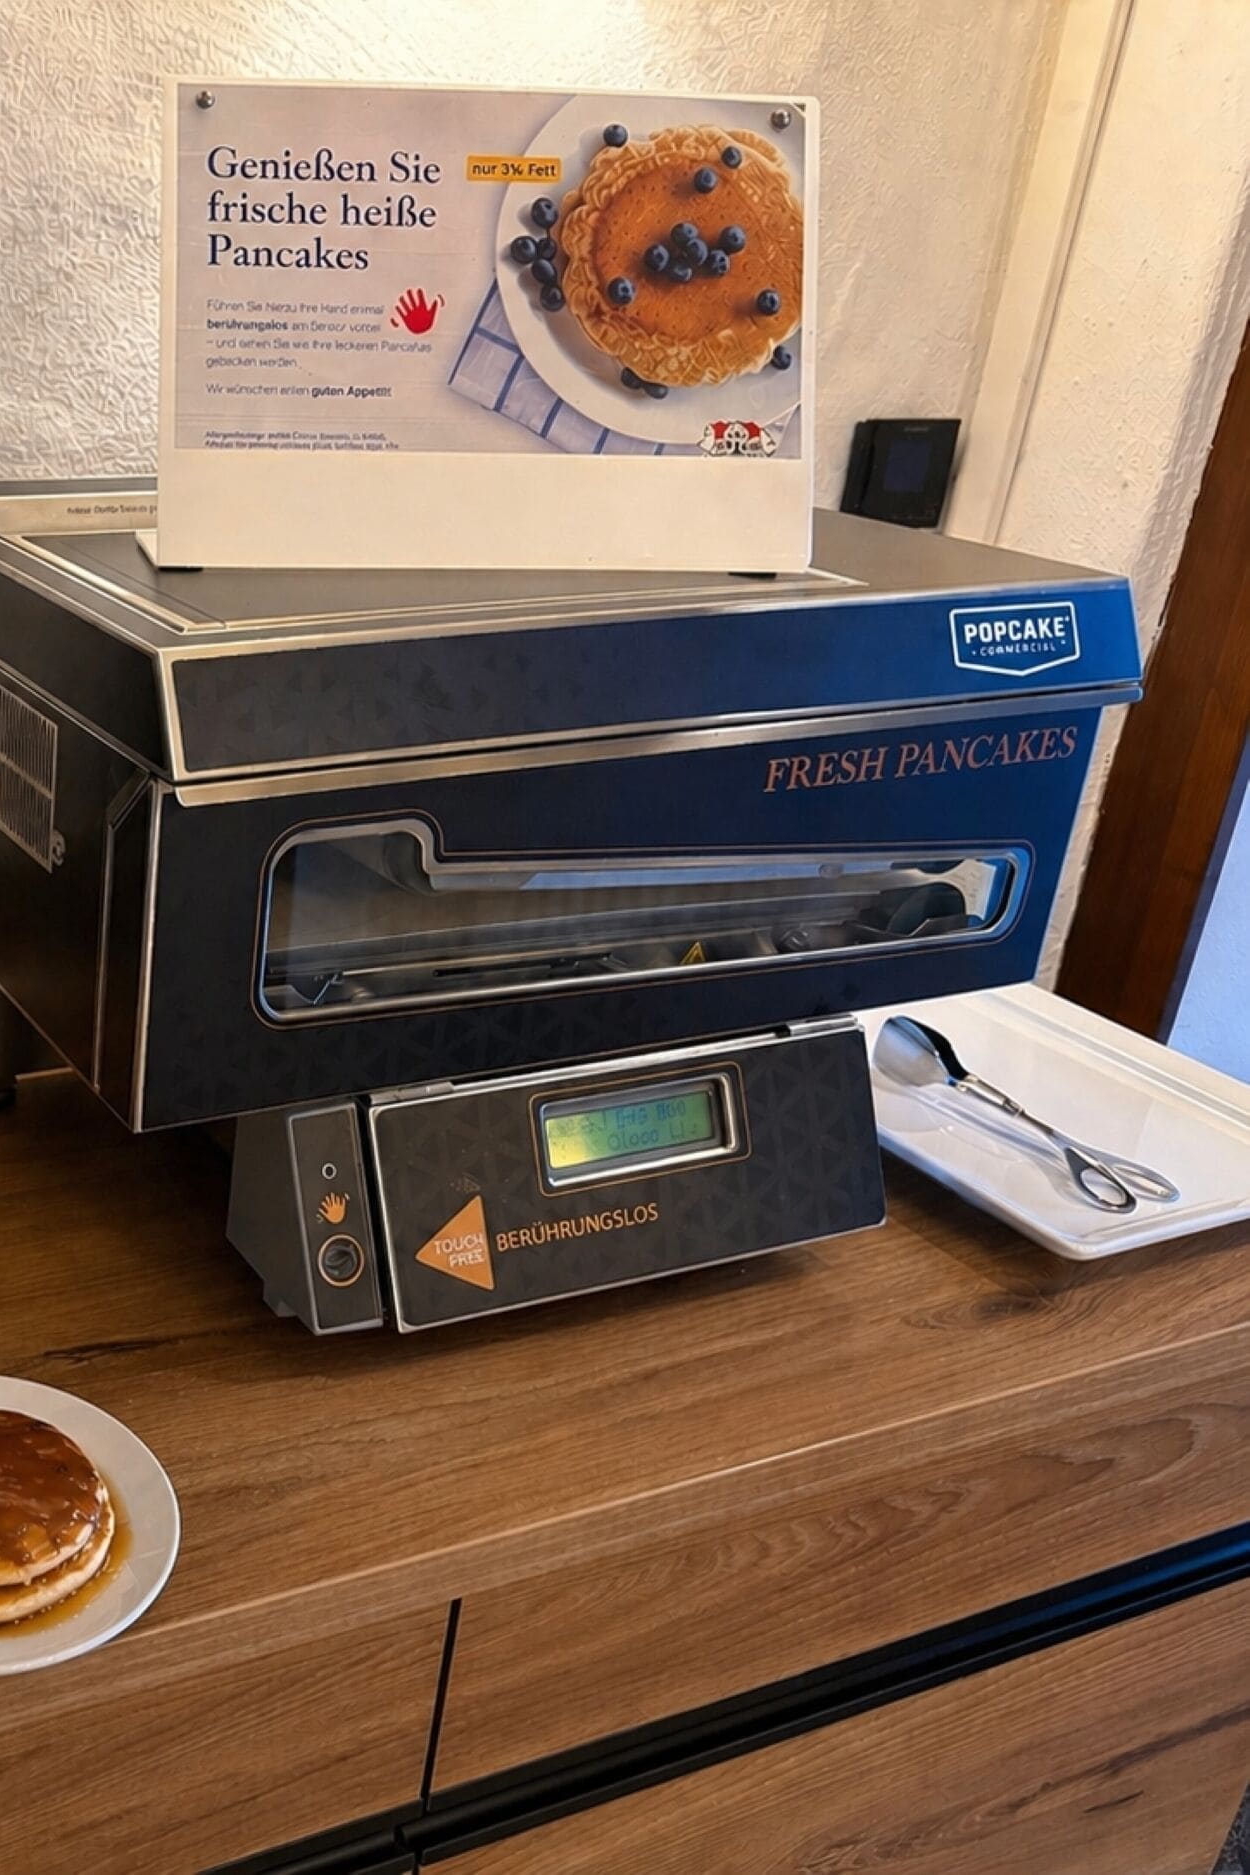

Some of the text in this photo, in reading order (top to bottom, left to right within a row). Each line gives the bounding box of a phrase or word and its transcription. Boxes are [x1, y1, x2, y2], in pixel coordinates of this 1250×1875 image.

[208, 146, 441, 183] Genießen Sie
[472, 163, 557, 177] nur 3% Fett
[207, 190, 438, 227] frische heiße
[207, 234, 369, 270] Pancakes
[963, 615, 1066, 644] POPCAKE
[763, 725, 1079, 793] FRESH PANCAKES
[434, 1232, 484, 1256] TOUCH
[495, 1202, 659, 1252] BERÜHRUNGSLOS
